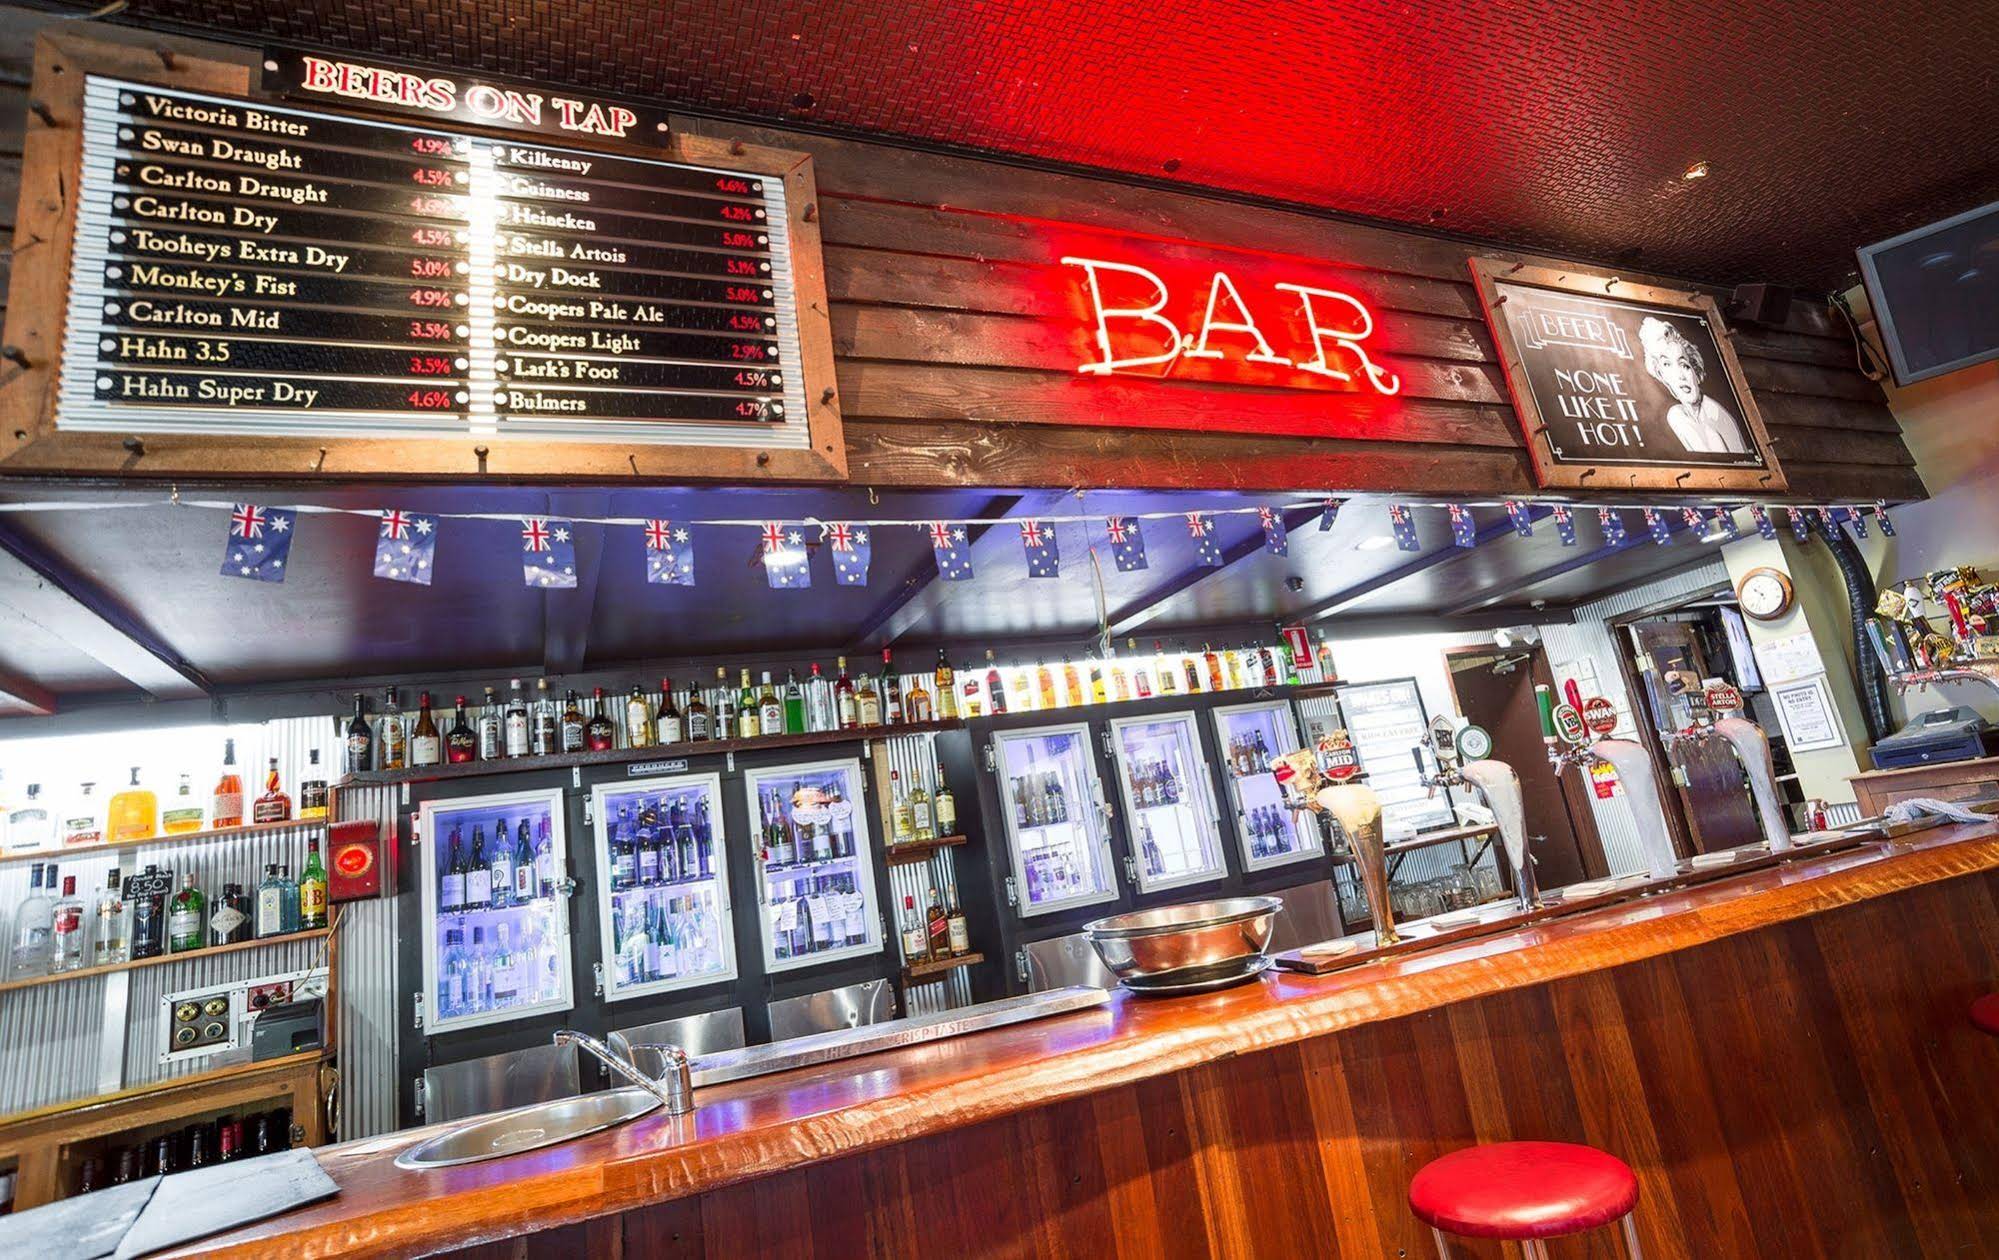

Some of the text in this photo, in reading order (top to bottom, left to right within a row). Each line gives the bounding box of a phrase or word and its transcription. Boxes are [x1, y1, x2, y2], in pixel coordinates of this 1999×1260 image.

[302, 56, 637, 138] BEERS ON TAP
[145, 95, 451, 155] Victoria Bitter 4.9%
[142, 131, 451, 185] Swan Draught 4.5%
[510, 148, 592, 175] Kilkenny
[140, 166, 234, 194] Carlton
[240, 175, 328, 205] Draught
[511, 178, 590, 202] Guinness
[134, 197, 451, 246] Carlton Dry 4.5%
[512, 206, 596, 232] Heineken
[132, 229, 450, 276] Tooheys Extra Dry 5.0%
[510, 236, 565, 258] Stella
[570, 244, 626, 263] Artois
[130, 264, 450, 308] Monkey's Fist 4.9%
[508, 264, 546, 285] Dry
[551, 268, 600, 289] Dock
[128, 302, 450, 340] Carlton Mid 3.5%
[507, 295, 585, 321] Coopers
[589, 301, 627, 320] Pale
[633, 306, 664, 323] Ale
[508, 327, 586, 351] Coopers
[591, 332, 641, 354] Light
[1060, 256, 1400, 395] BAR
[1538, 313, 1607, 343] BEER
[120, 337, 450, 374] Hahn 3.5 3.5%
[514, 358, 767, 388] Lark's Foot 4.5%
[1554, 368, 1627, 396] NONE
[122, 376, 450, 408] Hahn Super Dry 4.6%
[509, 391, 768, 417] Bulmers 4.7%
[1558, 395, 1640, 422] LIKE IT
[1711, 692, 1736, 700] STELLA
[1326, 754, 1353, 768] MID
